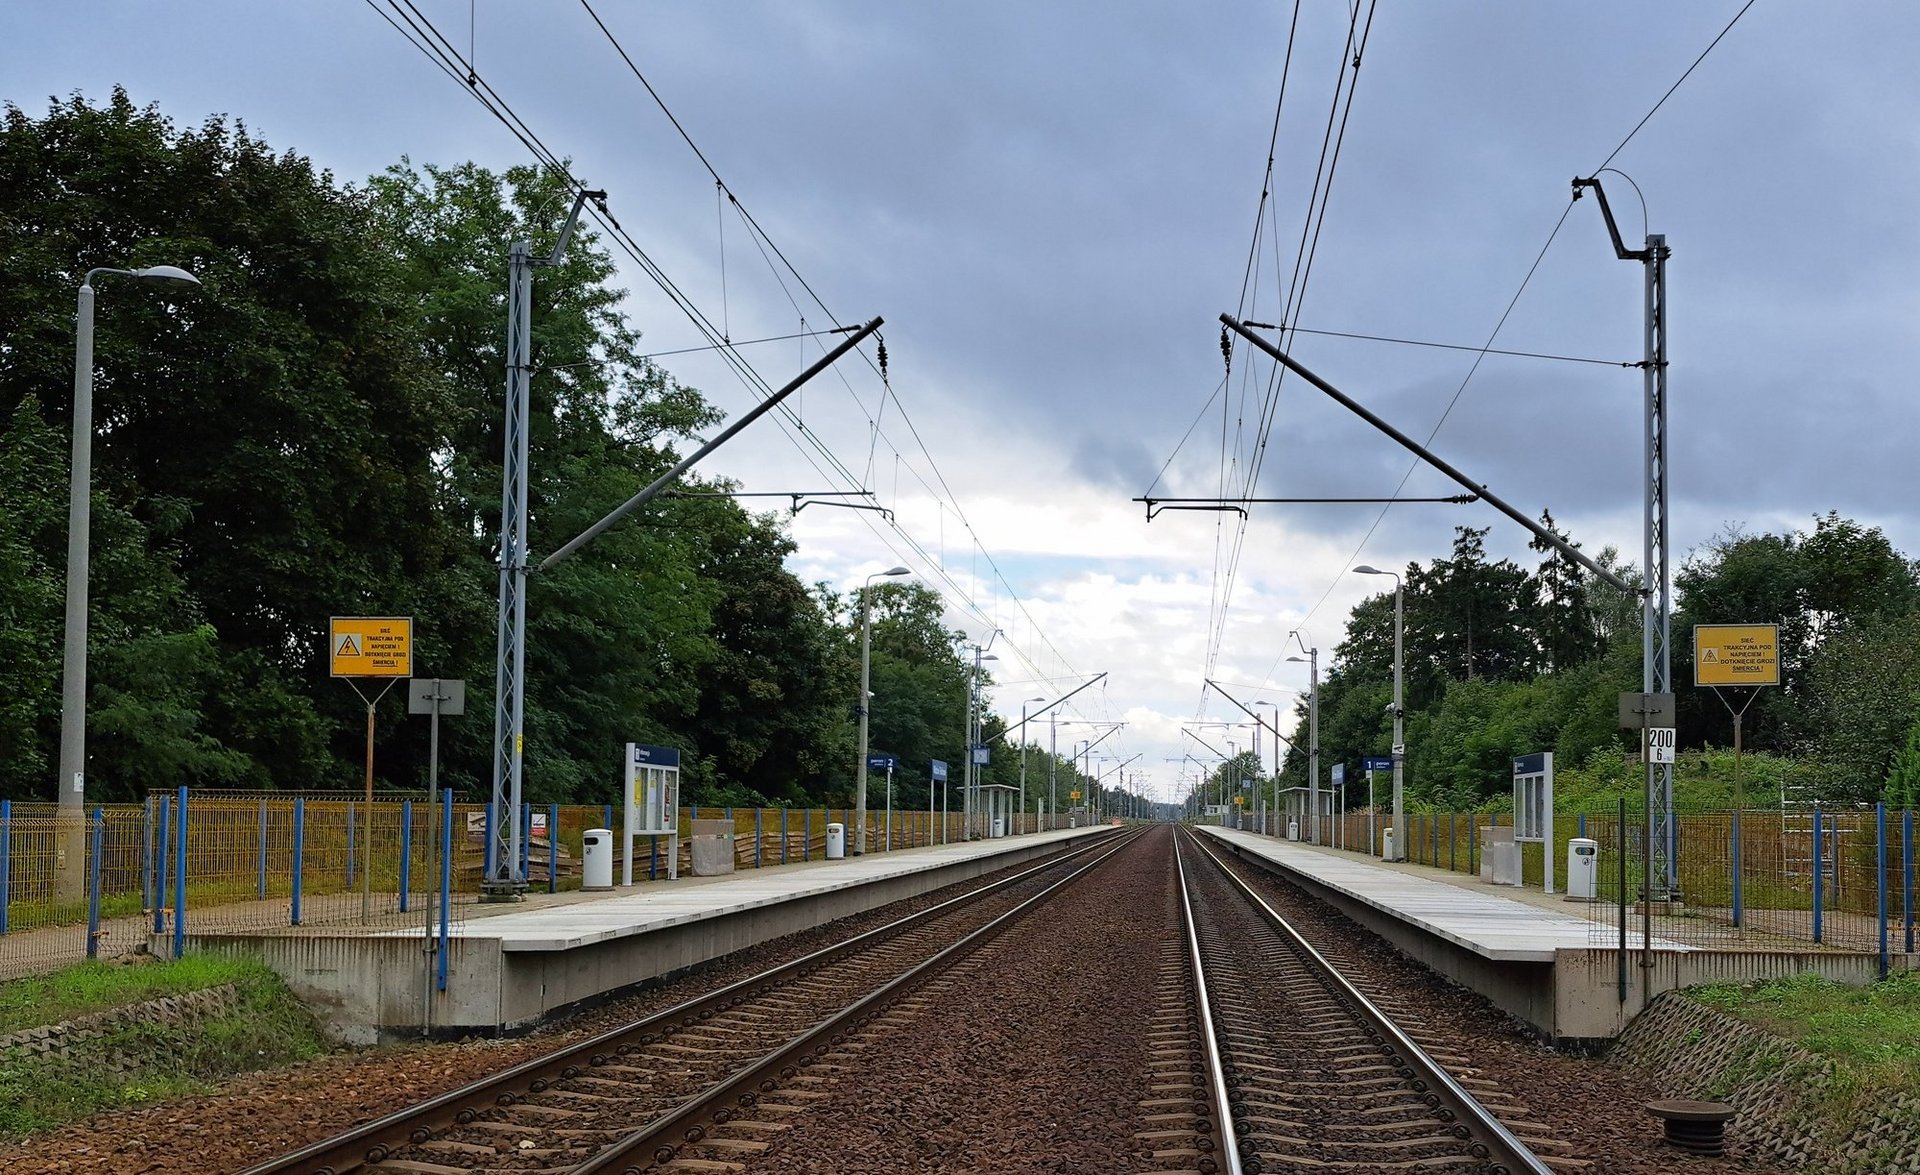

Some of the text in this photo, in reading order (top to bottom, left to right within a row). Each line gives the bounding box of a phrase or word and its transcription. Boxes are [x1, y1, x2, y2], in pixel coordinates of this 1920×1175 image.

[1656, 747, 1663, 761] 6
[887, 758, 894, 767] 2
[1367, 761, 1372, 769] 1
